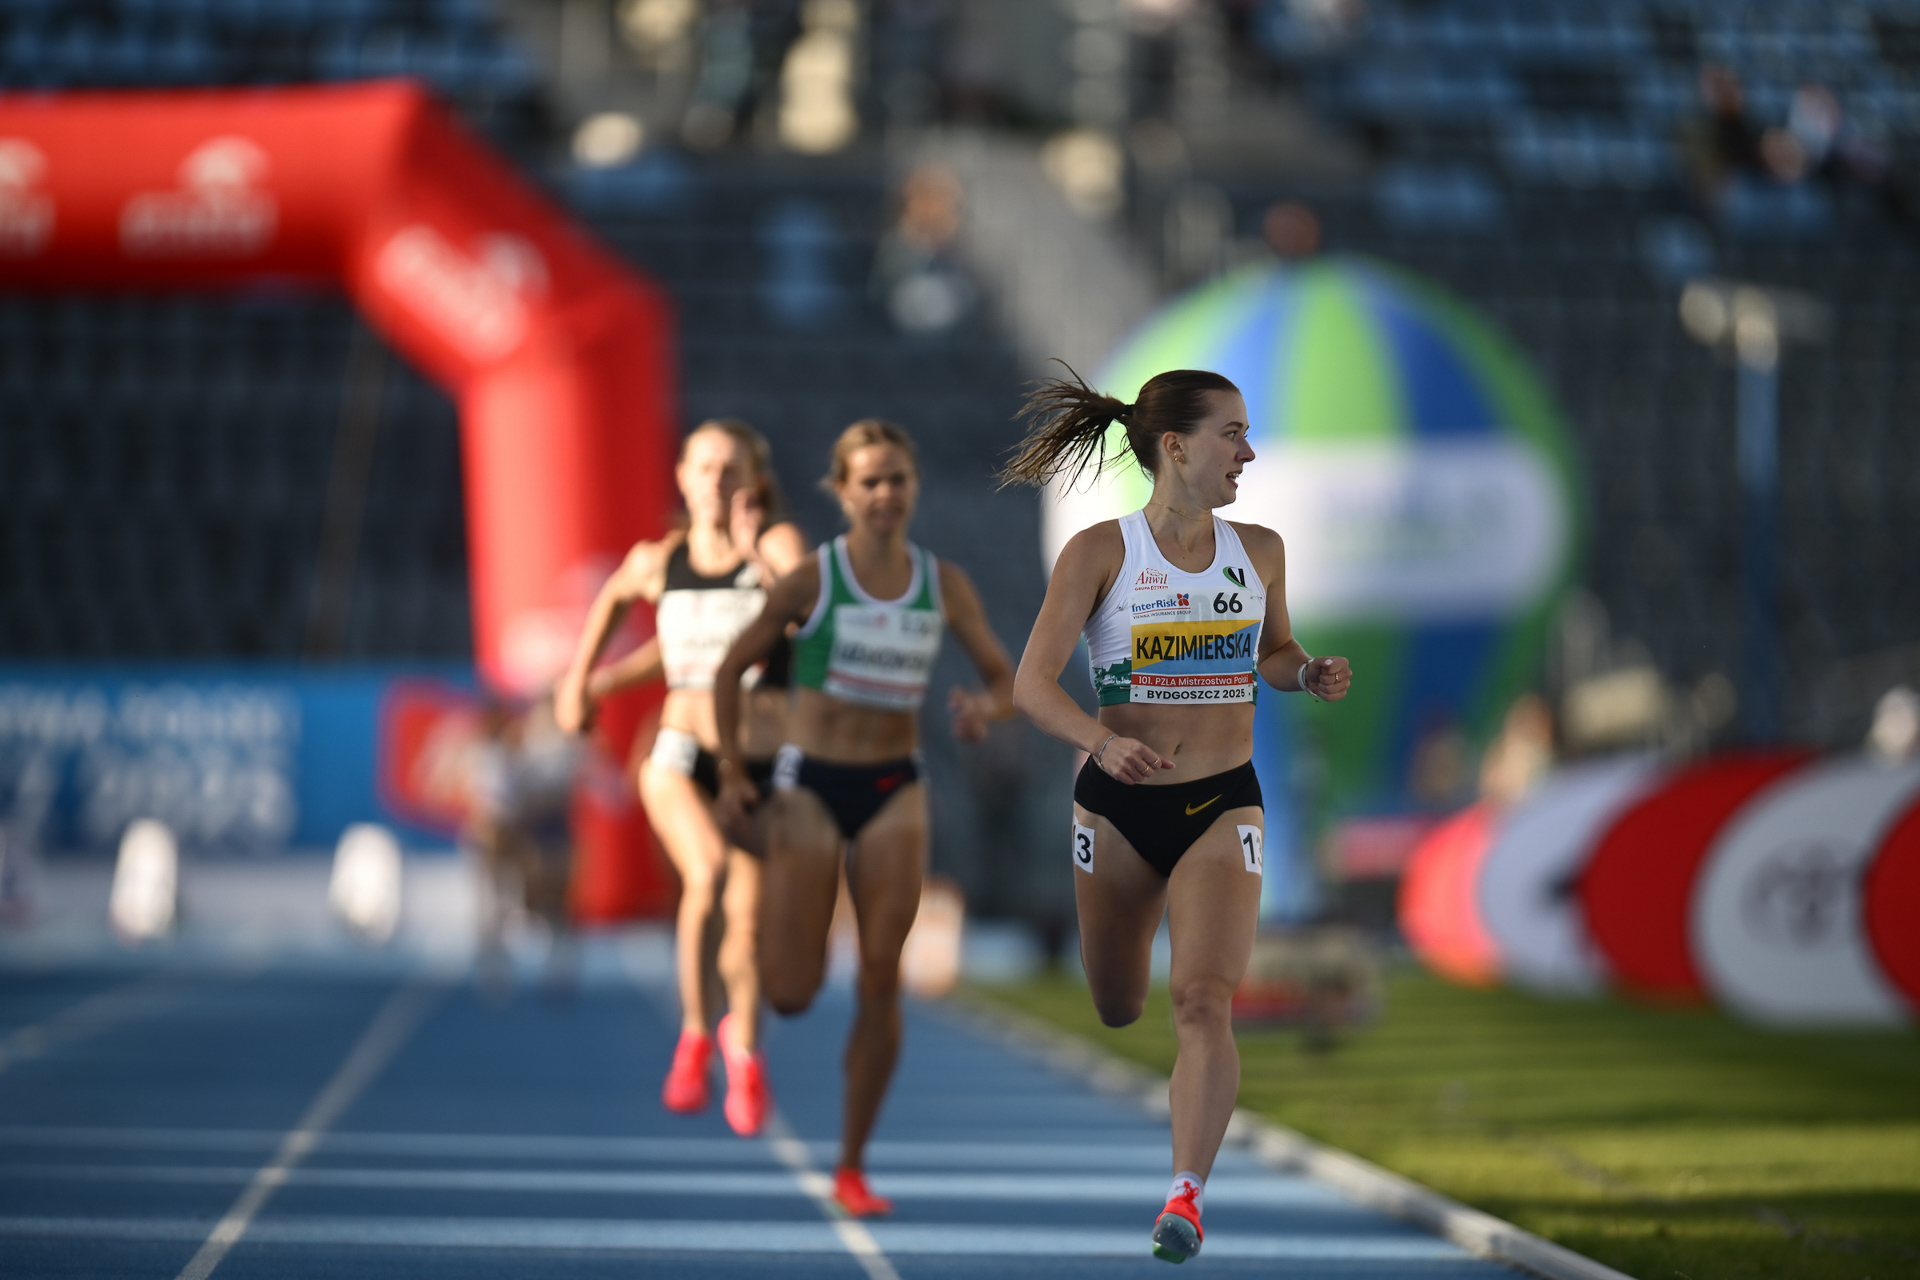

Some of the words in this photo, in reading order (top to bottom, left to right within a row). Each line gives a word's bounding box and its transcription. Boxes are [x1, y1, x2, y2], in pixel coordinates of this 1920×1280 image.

[1135, 571, 1168, 585] Anwil
[1131, 599, 1177, 612] InterRisk
[1213, 592, 1243, 613] 66
[1136, 633, 1251, 661] KAZIMIERSKA
[1138, 675, 1153, 685] 101.
[1155, 676, 1176, 686] PZLA
[1178, 676, 1232, 686] Mistrzostwa
[1147, 689, 1220, 699] BYDGOSZCZ
[1222, 689, 1245, 698] 2025
